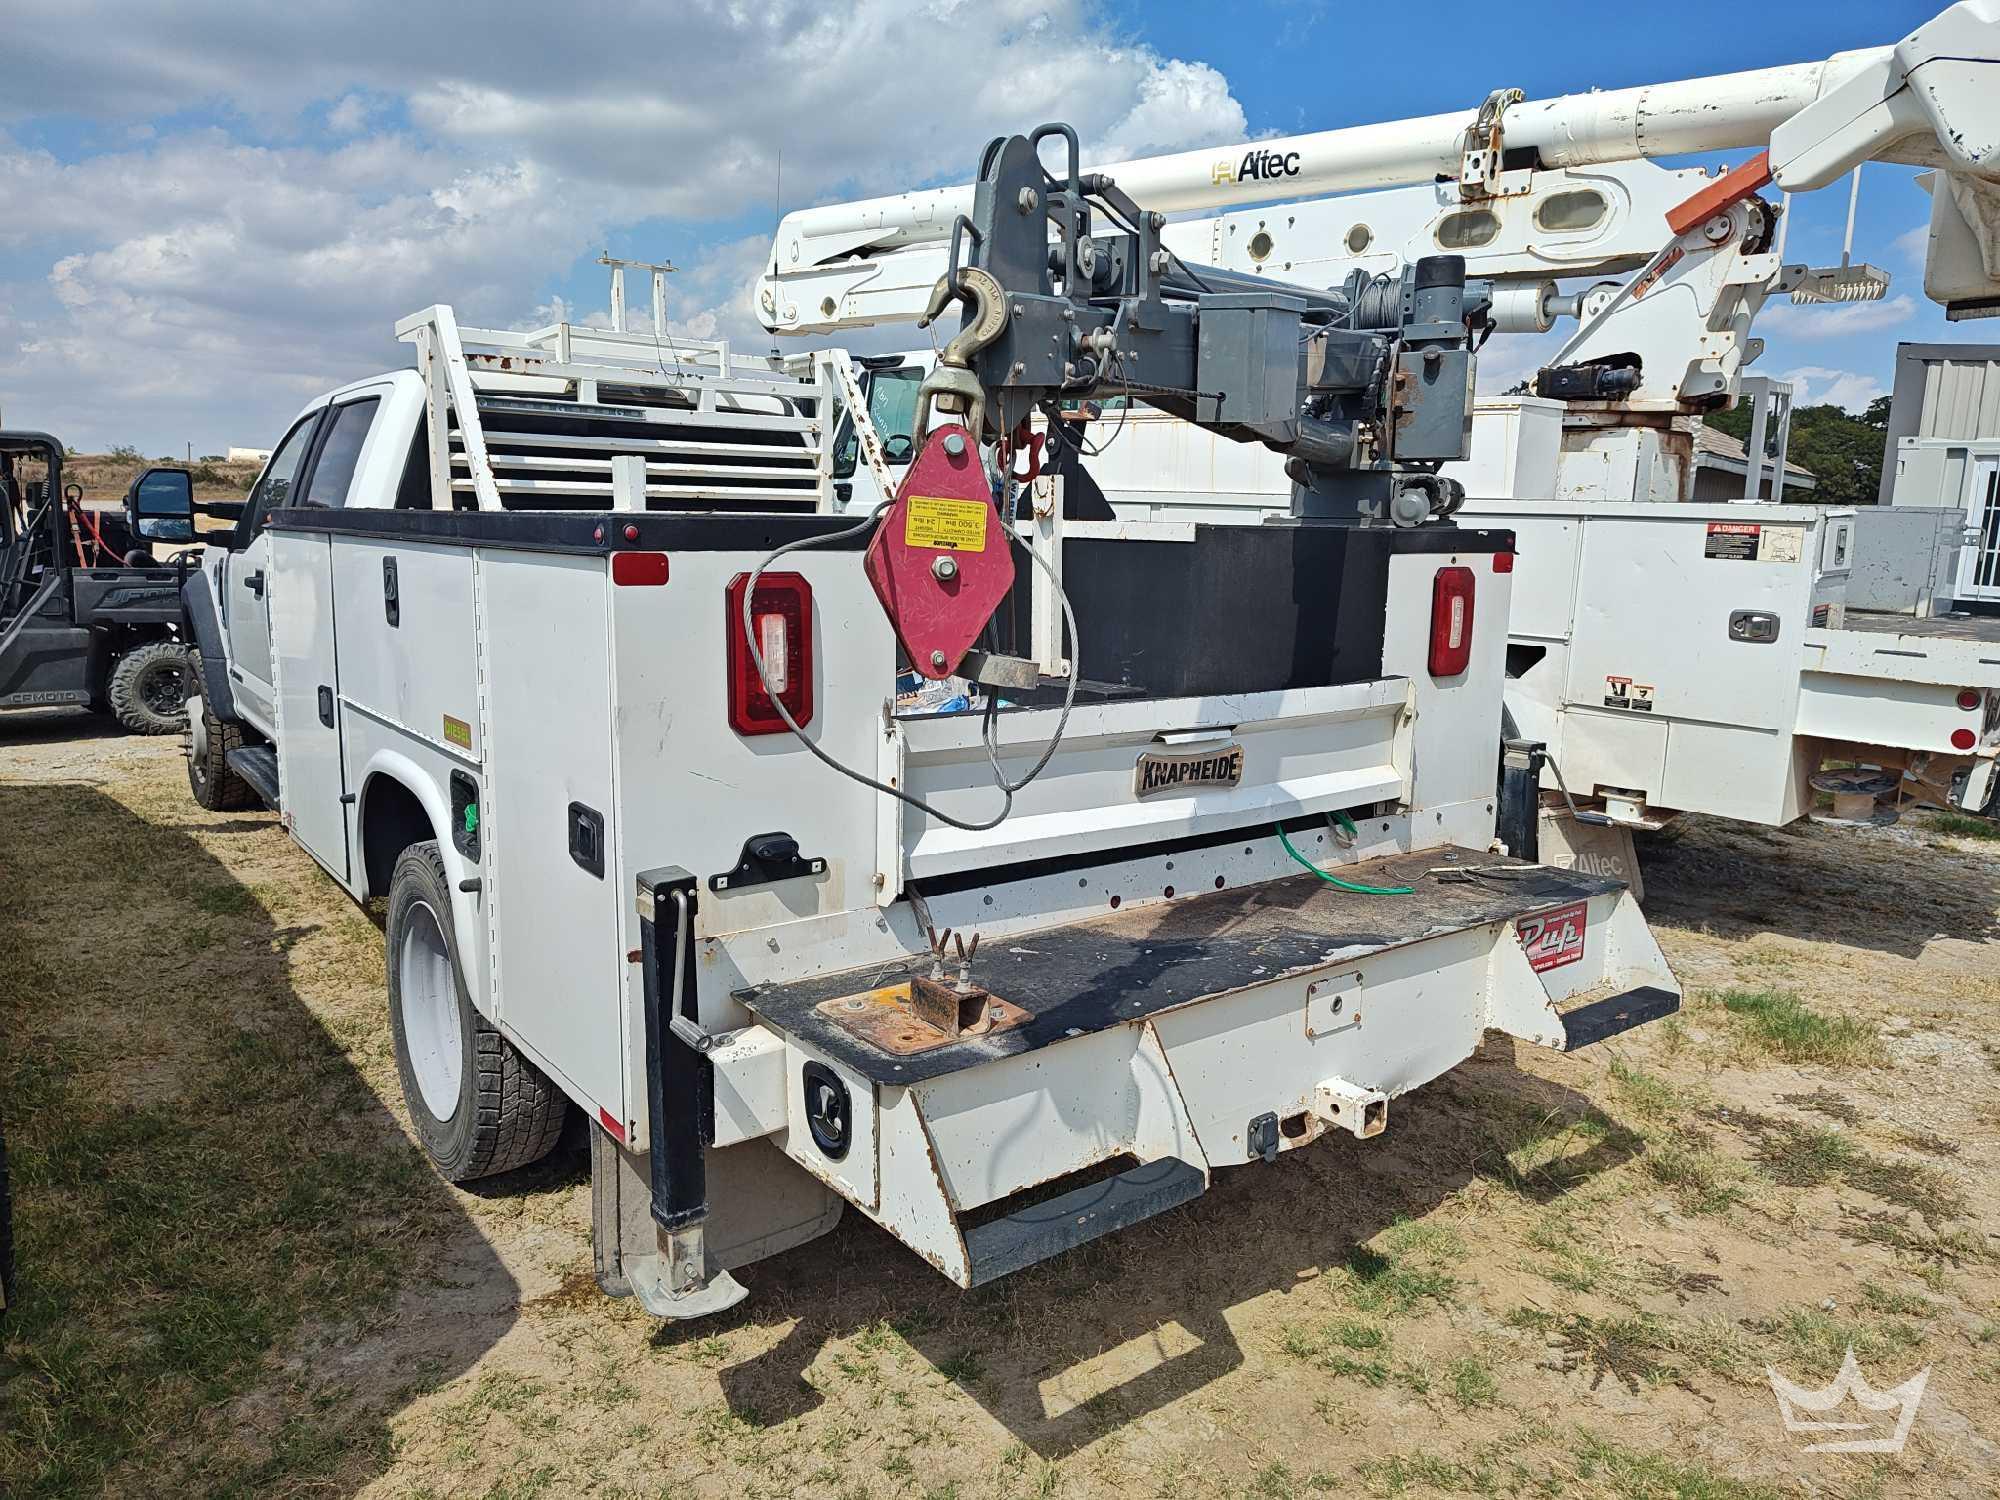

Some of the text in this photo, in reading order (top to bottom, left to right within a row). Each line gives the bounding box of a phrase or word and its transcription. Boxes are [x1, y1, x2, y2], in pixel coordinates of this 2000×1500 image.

[1238, 149, 1300, 183] Altec
[1721, 524, 1755, 533] DANGER
[11, 691, 76, 704] CFMOTO
[445, 719, 470, 744] DIESEL
[1143, 752, 1240, 790] KNAPHEIDE
[1579, 853, 1623, 876] Altec
